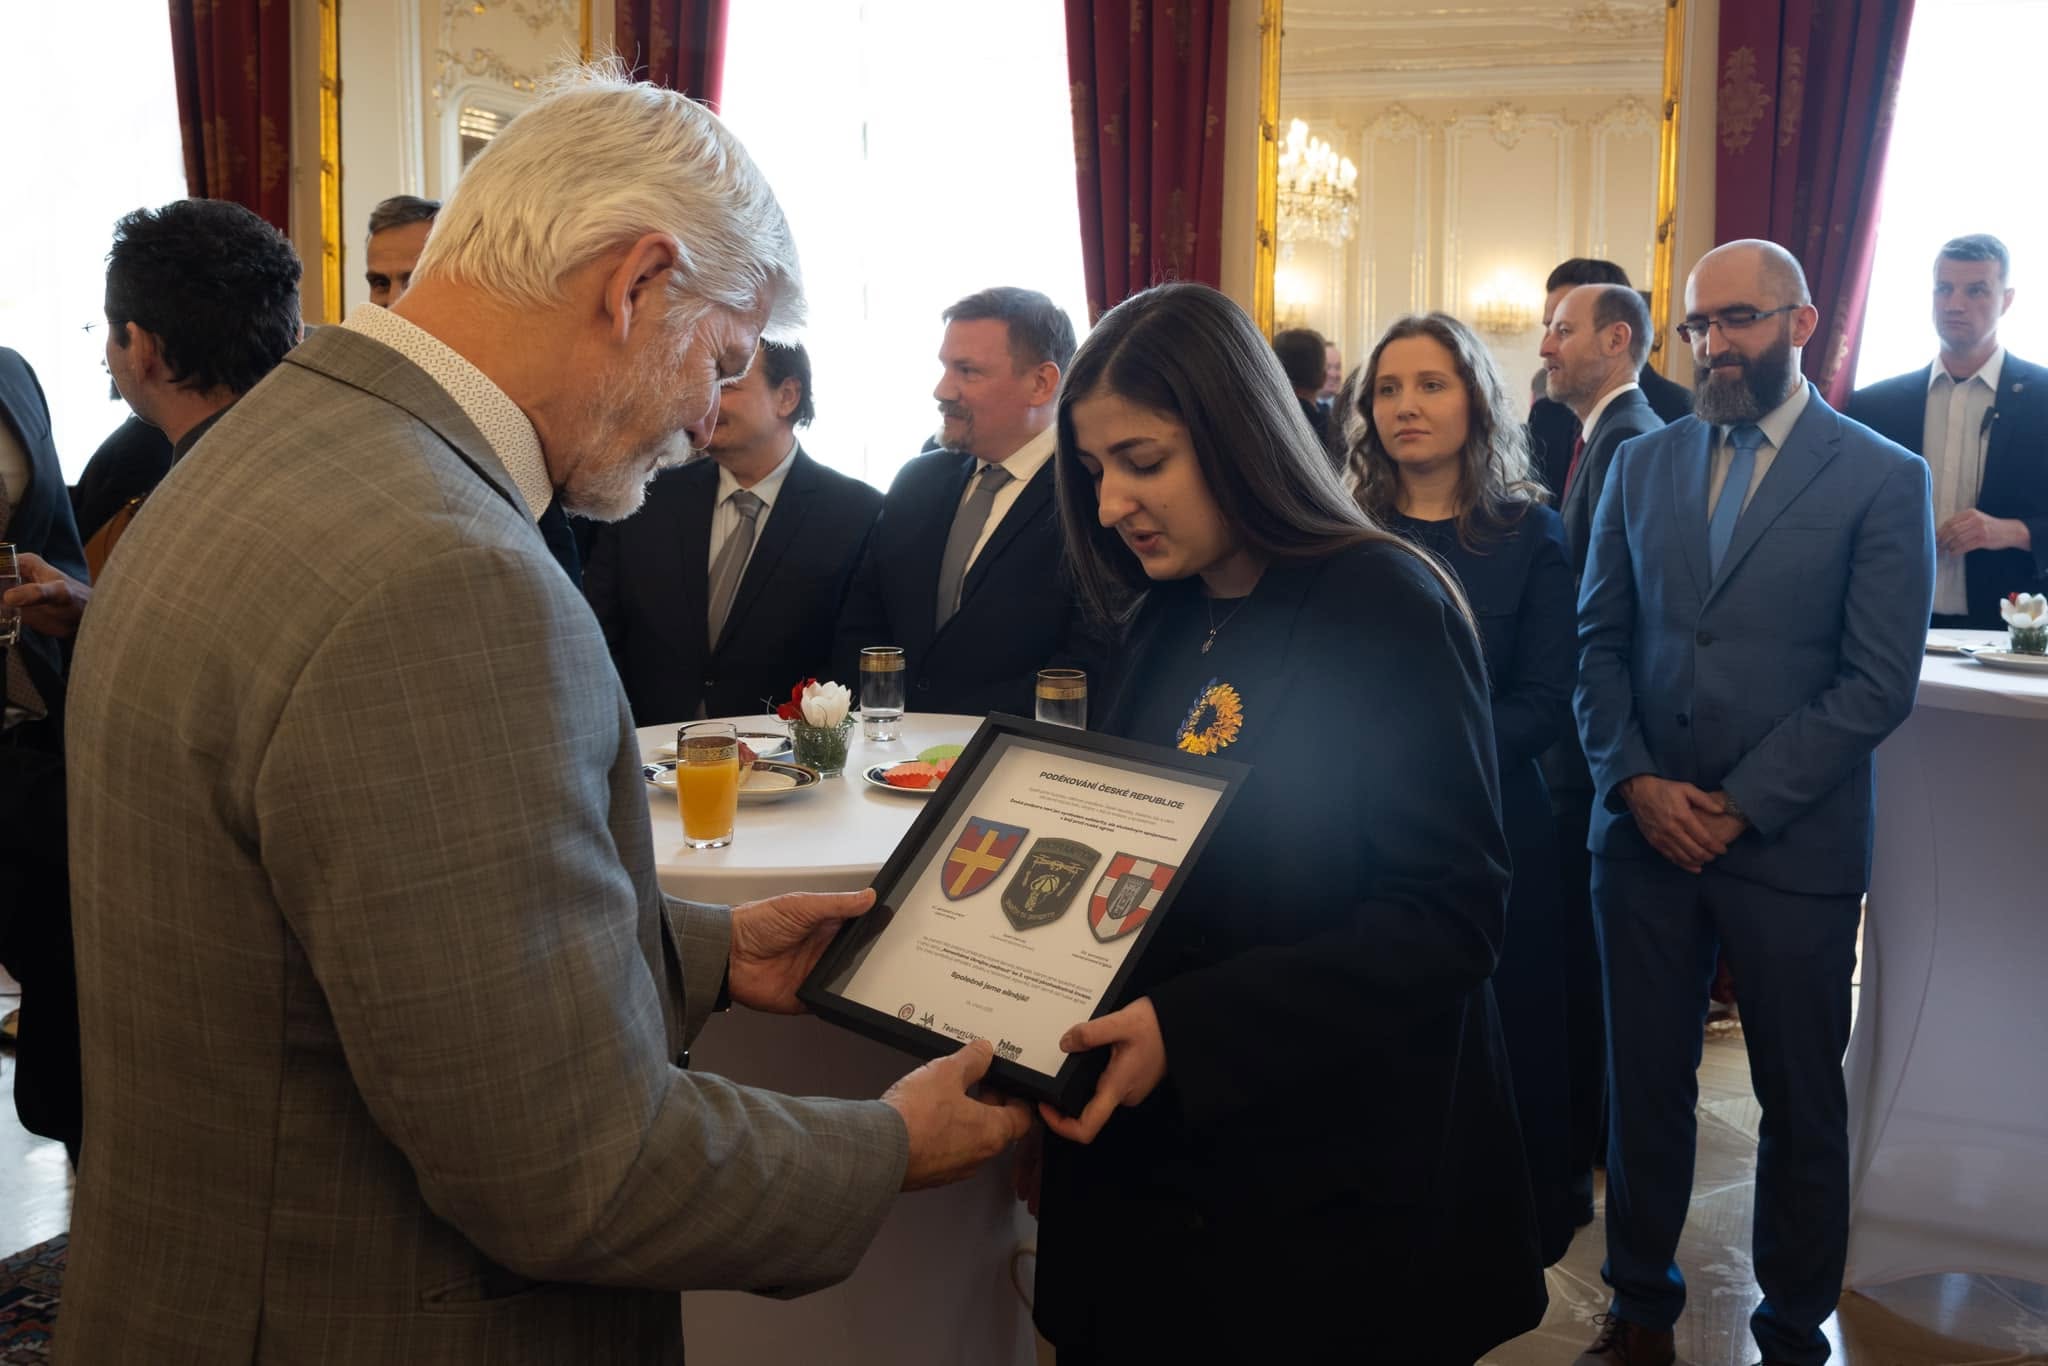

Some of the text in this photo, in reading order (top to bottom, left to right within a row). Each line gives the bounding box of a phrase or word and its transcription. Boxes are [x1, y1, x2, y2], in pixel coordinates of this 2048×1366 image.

[1040, 771, 1099, 790] PODĚKOVÁNÍ
[1098, 783, 1131, 797] ČESKÉ
[1130, 791, 1185, 809] REPUBLICE
